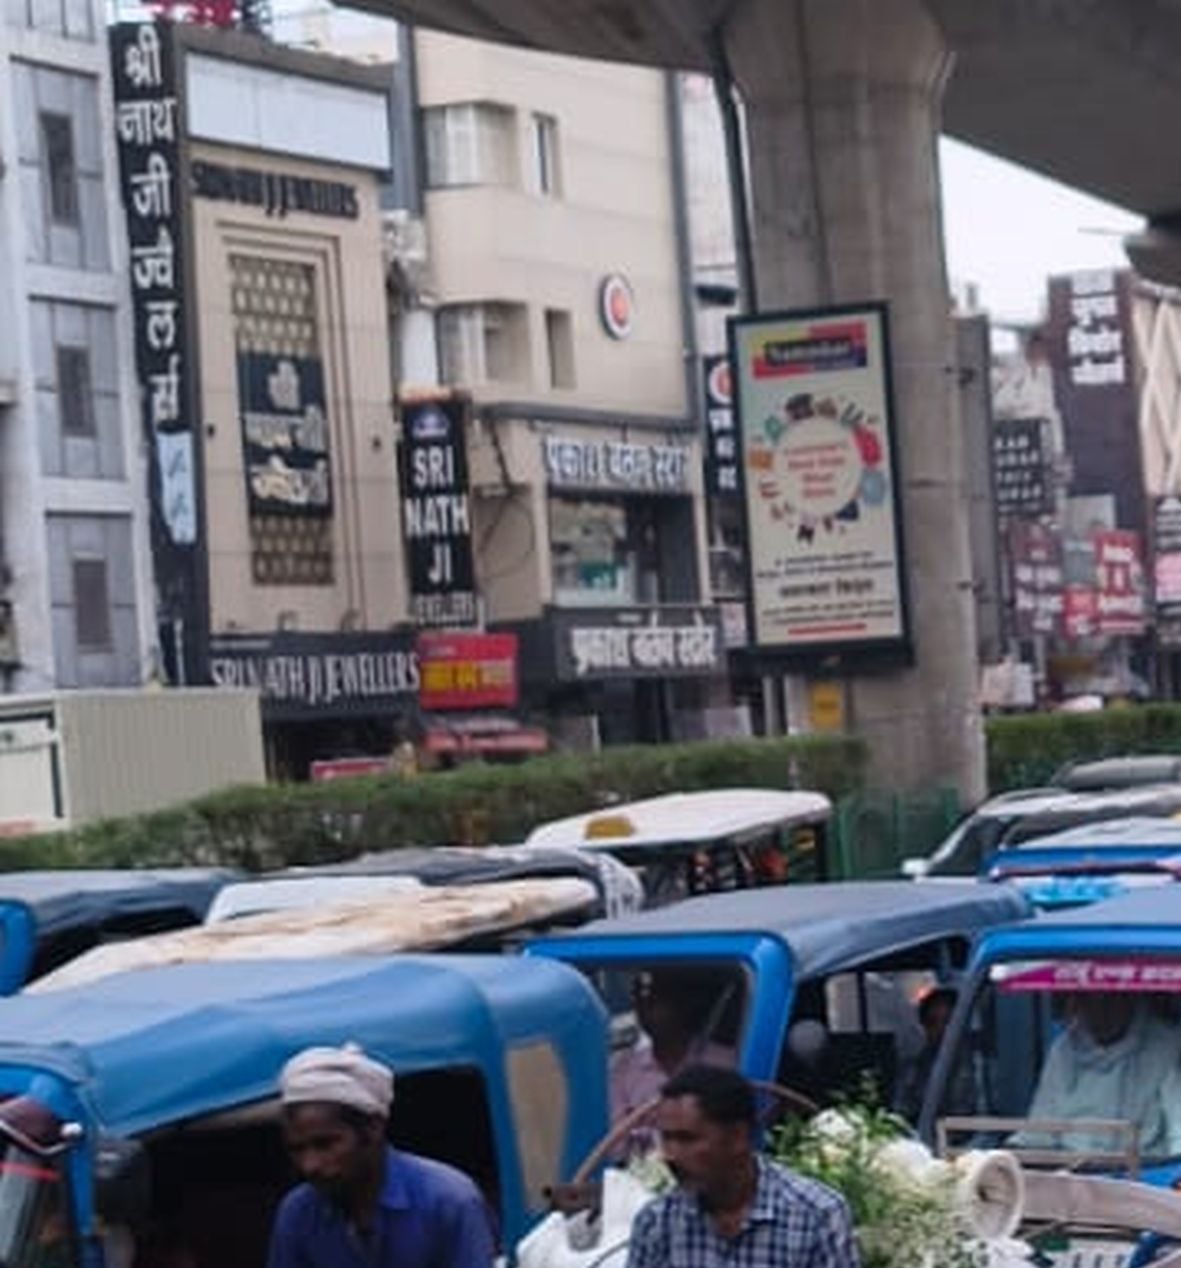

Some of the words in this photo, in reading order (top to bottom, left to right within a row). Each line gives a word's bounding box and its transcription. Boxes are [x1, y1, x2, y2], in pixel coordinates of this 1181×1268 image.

[126, 25, 162, 87] श्री
[118, 98, 176, 145] नाथ
[130, 153, 173, 218] जी
[412, 446, 455, 488] SRI
[405, 497, 470, 537] NATH
[428, 547, 453, 582] JI
[323, 651, 421, 704] JEWELLERS
